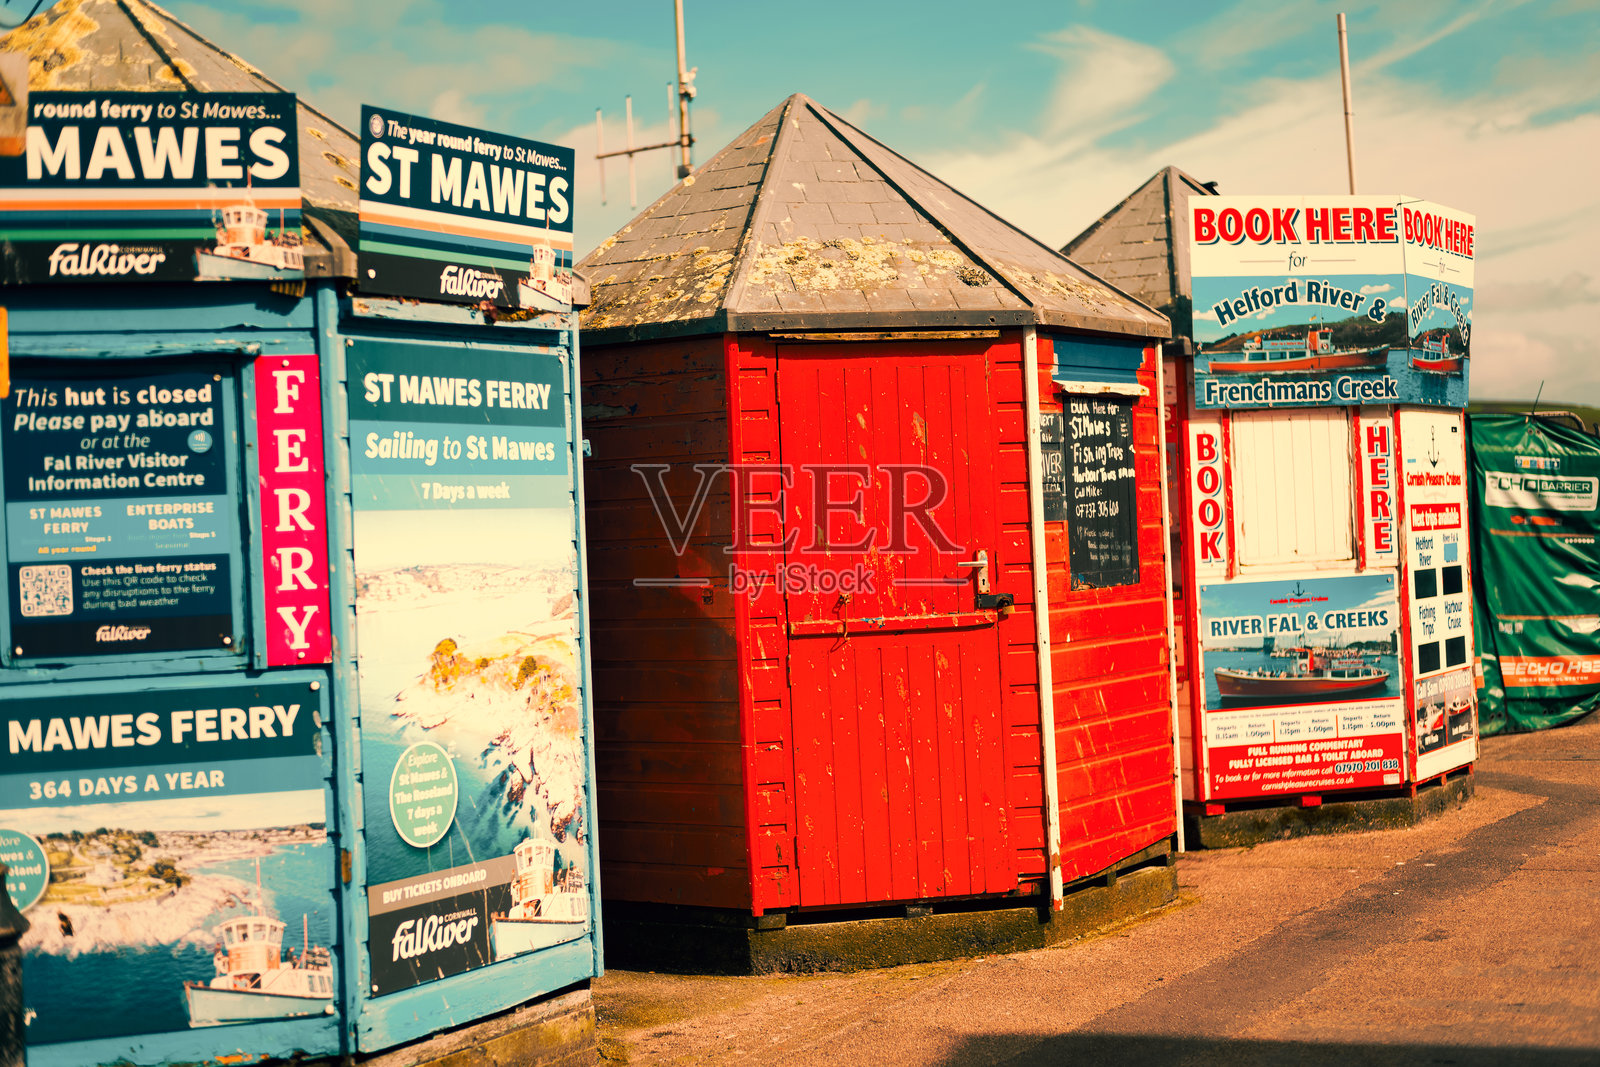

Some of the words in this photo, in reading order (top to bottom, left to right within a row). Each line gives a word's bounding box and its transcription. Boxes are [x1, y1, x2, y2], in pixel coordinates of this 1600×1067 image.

[34, 100, 96, 118] round
[100, 100, 152, 122] ferry
[157, 103, 176, 118] to
[180, 103, 199, 118] St
[203, 102, 281, 119] Mawes...
[26, 126, 290, 180] MAWES
[387, 120, 408, 139] The
[408, 125, 436, 145] year
[437, 131, 472, 153] round
[474, 137, 502, 161] ferry
[503, 145, 514, 160] to
[514, 147, 526, 163] St
[526, 150, 566, 171] Mawes...
[366, 141, 418, 198] ST
[431, 153, 569, 224] MAWES
[1194, 207, 1300, 244] BOOK
[1306, 207, 1399, 244] HERE
[1404, 207, 1444, 252] BOOK
[1445, 218, 1474, 260] HERE
[1288, 251, 1308, 270] for
[1212, 282, 1298, 328] Helford
[1307, 281, 1364, 312] River
[1368, 298, 1386, 322] &
[1411, 292, 1430, 330] River
[1431, 282, 1443, 305] Fal
[14, 388, 58, 407] This
[65, 388, 106, 406] hut
[113, 388, 130, 406] is
[136, 384, 212, 404] closed
[364, 372, 394, 403] ST
[400, 375, 482, 407] MAWES
[486, 380, 551, 410] FERRY
[1205, 379, 1331, 404] Frenchmans
[1336, 375, 1399, 400] Creek
[14, 414, 85, 431] Please
[91, 414, 131, 432] pay
[136, 408, 214, 427] aboard
[80, 436, 99, 450] or
[102, 435, 120, 449] at
[124, 433, 150, 448] the
[365, 431, 438, 466] Sailing
[443, 436, 462, 460] to
[466, 435, 488, 460] St
[492, 436, 555, 461] Mawes
[44, 456, 72, 471] Fal
[76, 454, 125, 470] River
[128, 452, 188, 468] Visitor
[28, 472, 140, 491] Information
[144, 471, 205, 488] Centre
[1407, 472, 1426, 486] Cornish
[1426, 472, 1444, 486] Pleasure
[1446, 472, 1462, 486] Cruises
[1542, 481, 1590, 492] BARRIER
[421, 483, 430, 499] 7
[433, 482, 465, 504] Days
[476, 482, 511, 499] week
[1196, 434, 1225, 563] BOOK
[1367, 426, 1393, 554] HERE
[30, 508, 46, 520] ST
[50, 506, 102, 519] MAWES
[126, 502, 214, 516] ENTERPRISE
[272, 370, 318, 650] FERRY
[1412, 508, 1425, 527] Next
[1438, 506, 1460, 526] available
[44, 522, 88, 534] FERRY
[148, 518, 194, 530] BOATS
[1416, 536, 1434, 550] Helford
[1419, 552, 1432, 566] River
[81, 566, 114, 576] Check
[116, 565, 134, 574] the
[134, 564, 154, 574] live
[156, 563, 182, 574] ferry
[184, 562, 216, 572] status
[82, 578, 100, 587] Use
[103, 577, 122, 586] this
[123, 576, 138, 586] QR
[140, 576, 164, 584] code
[178, 574, 208, 582] check
[83, 590, 100, 600] any
[103, 586, 160, 598] disruptions
[161, 586, 172, 594] to
[174, 585, 190, 594] the
[192, 584, 216, 594] ferry
[83, 600, 116, 610] during
[118, 598, 137, 608] bad
[139, 598, 179, 606] weather
[1419, 604, 1436, 622] Fishing
[1445, 600, 1462, 616] Harbour
[1210, 618, 1262, 637] RIVER
[1268, 616, 1302, 633] FAL
[1307, 614, 1318, 630] &
[1324, 610, 1388, 629] CREEKS
[1422, 622, 1434, 639] Trips
[1448, 616, 1462, 630] Cruise
[1516, 662, 1564, 676] ECHO
[8, 712, 162, 754] MAWES
[171, 704, 300, 744] FERRY
[1248, 746, 1268, 756] FULL
[1270, 742, 1308, 755] RUNNING
[1309, 739, 1364, 753] COMMENTARY
[408, 752, 438, 768] Explore
[1229, 758, 1254, 770] FULLY
[1256, 755, 1294, 768] LICENSED
[1295, 754, 1312, 765] BAR
[1321, 750, 1348, 762] TOILET
[1350, 748, 1383, 760] ABOARD
[1215, 774, 1224, 784] To
[1225, 773, 1242, 782] book
[1252, 772, 1261, 782] for
[1263, 771, 1280, 780] more
[1282, 768, 1320, 780] information
[1321, 766, 1333, 776] call
[1335, 762, 1363, 774] 07970
[1364, 760, 1380, 772] 201
[1382, 759, 1399, 770] 838
[30, 780, 72, 800] 364
[79, 775, 138, 796] DAYS
[144, 774, 160, 792] A
[165, 770, 225, 790] YEAR
[413, 783, 452, 801] Roseland
[1262, 776, 1354, 791] cornishpleasurecruises.co.uk
[414, 806, 436, 820] days
[414, 821, 438, 837] week
[382, 889, 402, 904] BUY
[403, 879, 442, 900] TICKETS
[443, 869, 486, 890] ONBOARD
[444, 908, 478, 922] CORNWALL
